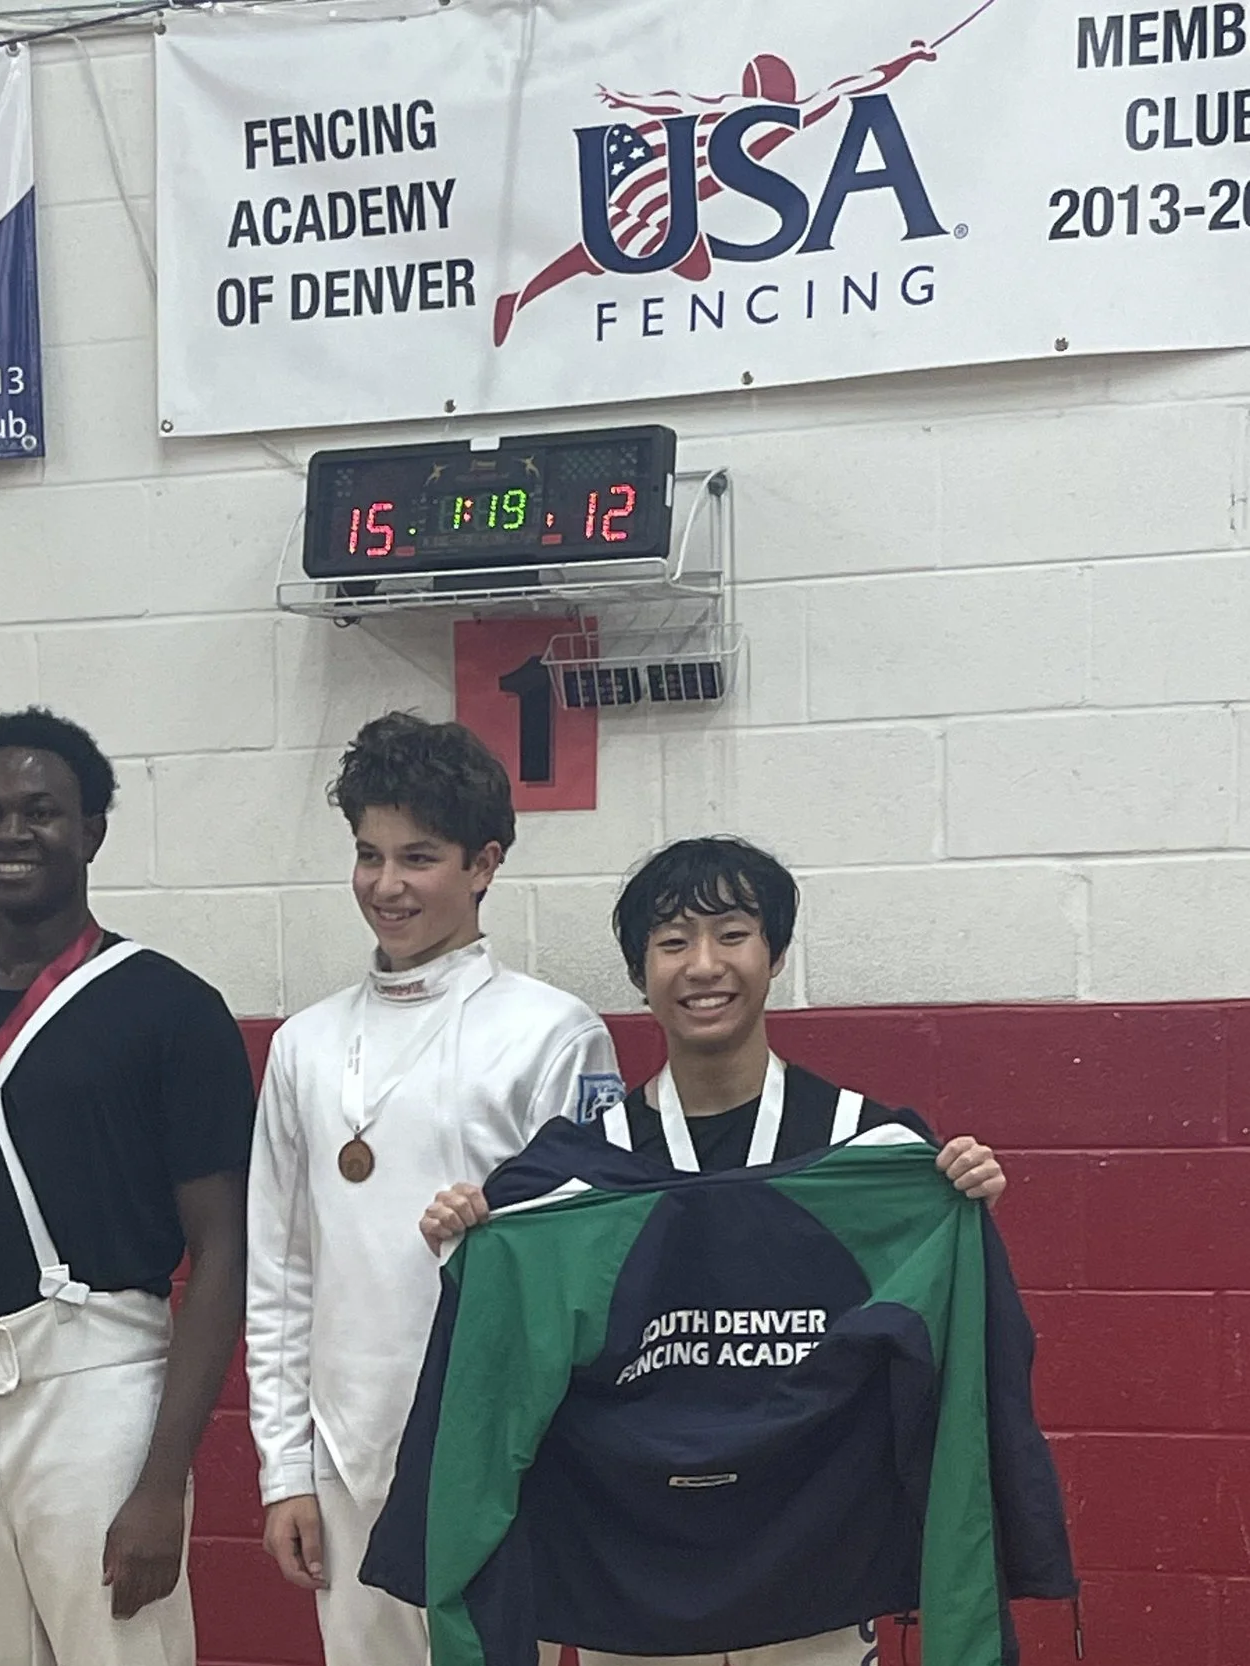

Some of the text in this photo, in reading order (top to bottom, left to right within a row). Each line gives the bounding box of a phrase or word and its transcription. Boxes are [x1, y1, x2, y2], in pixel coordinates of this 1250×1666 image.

[244, 99, 438, 170] FENCING
[227, 178, 457, 248] ACADEMY
[1049, 178, 1250, 241] 2013-2
[217, 258, 476, 327] OF DENVER
[596, 265, 936, 341] FENCING
[348, 482, 637, 557] 15 1:19 12
[498, 655, 553, 785] 1
[640, 1309, 828, 1351] OUTH DENVER
[716, 1342, 821, 1367] ACADE
